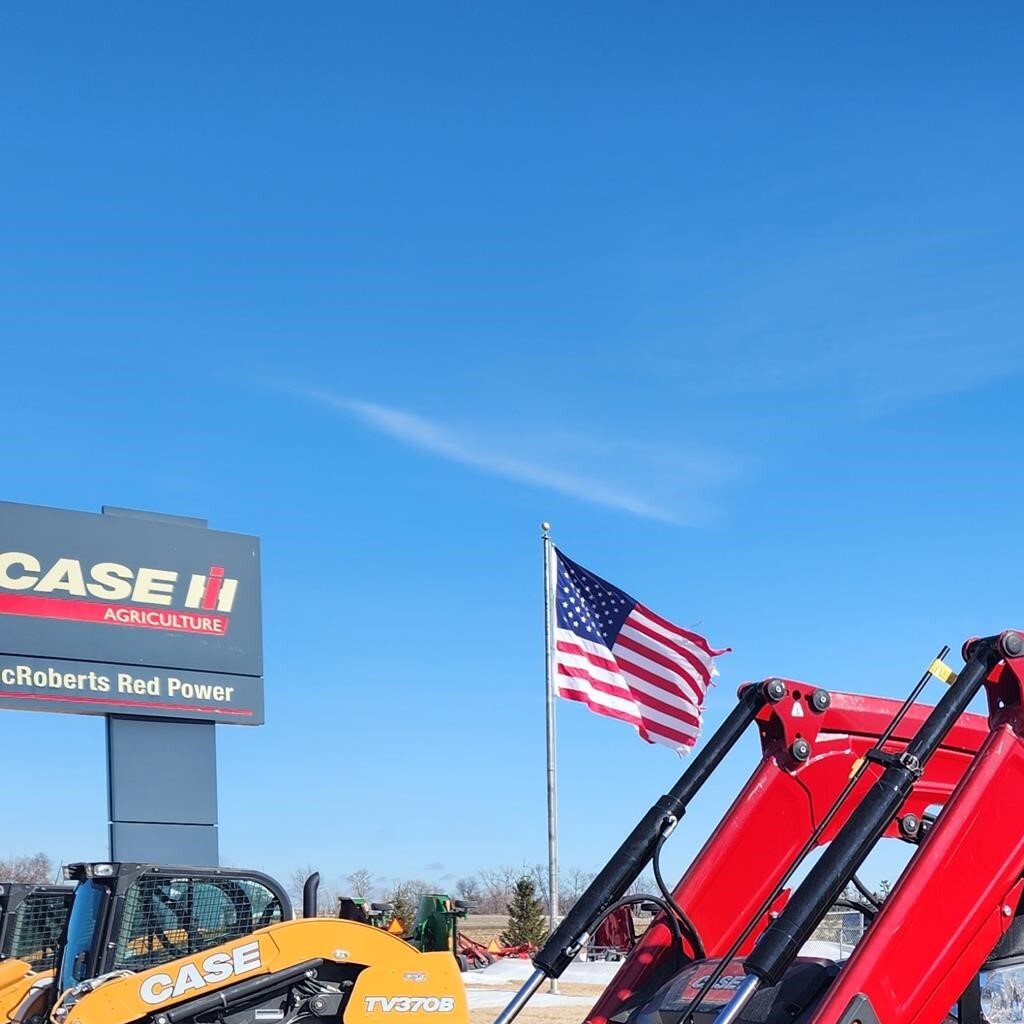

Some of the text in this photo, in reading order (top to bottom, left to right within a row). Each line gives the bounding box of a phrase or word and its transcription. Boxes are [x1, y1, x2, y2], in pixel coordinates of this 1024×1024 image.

[0, 552, 178, 606] CASE
[104, 608, 222, 632] AGRICULTURE
[118, 673, 160, 697] Red
[167, 677, 235, 702] Power
[139, 940, 262, 1005] CASE
[364, 996, 455, 1012] TV370B
